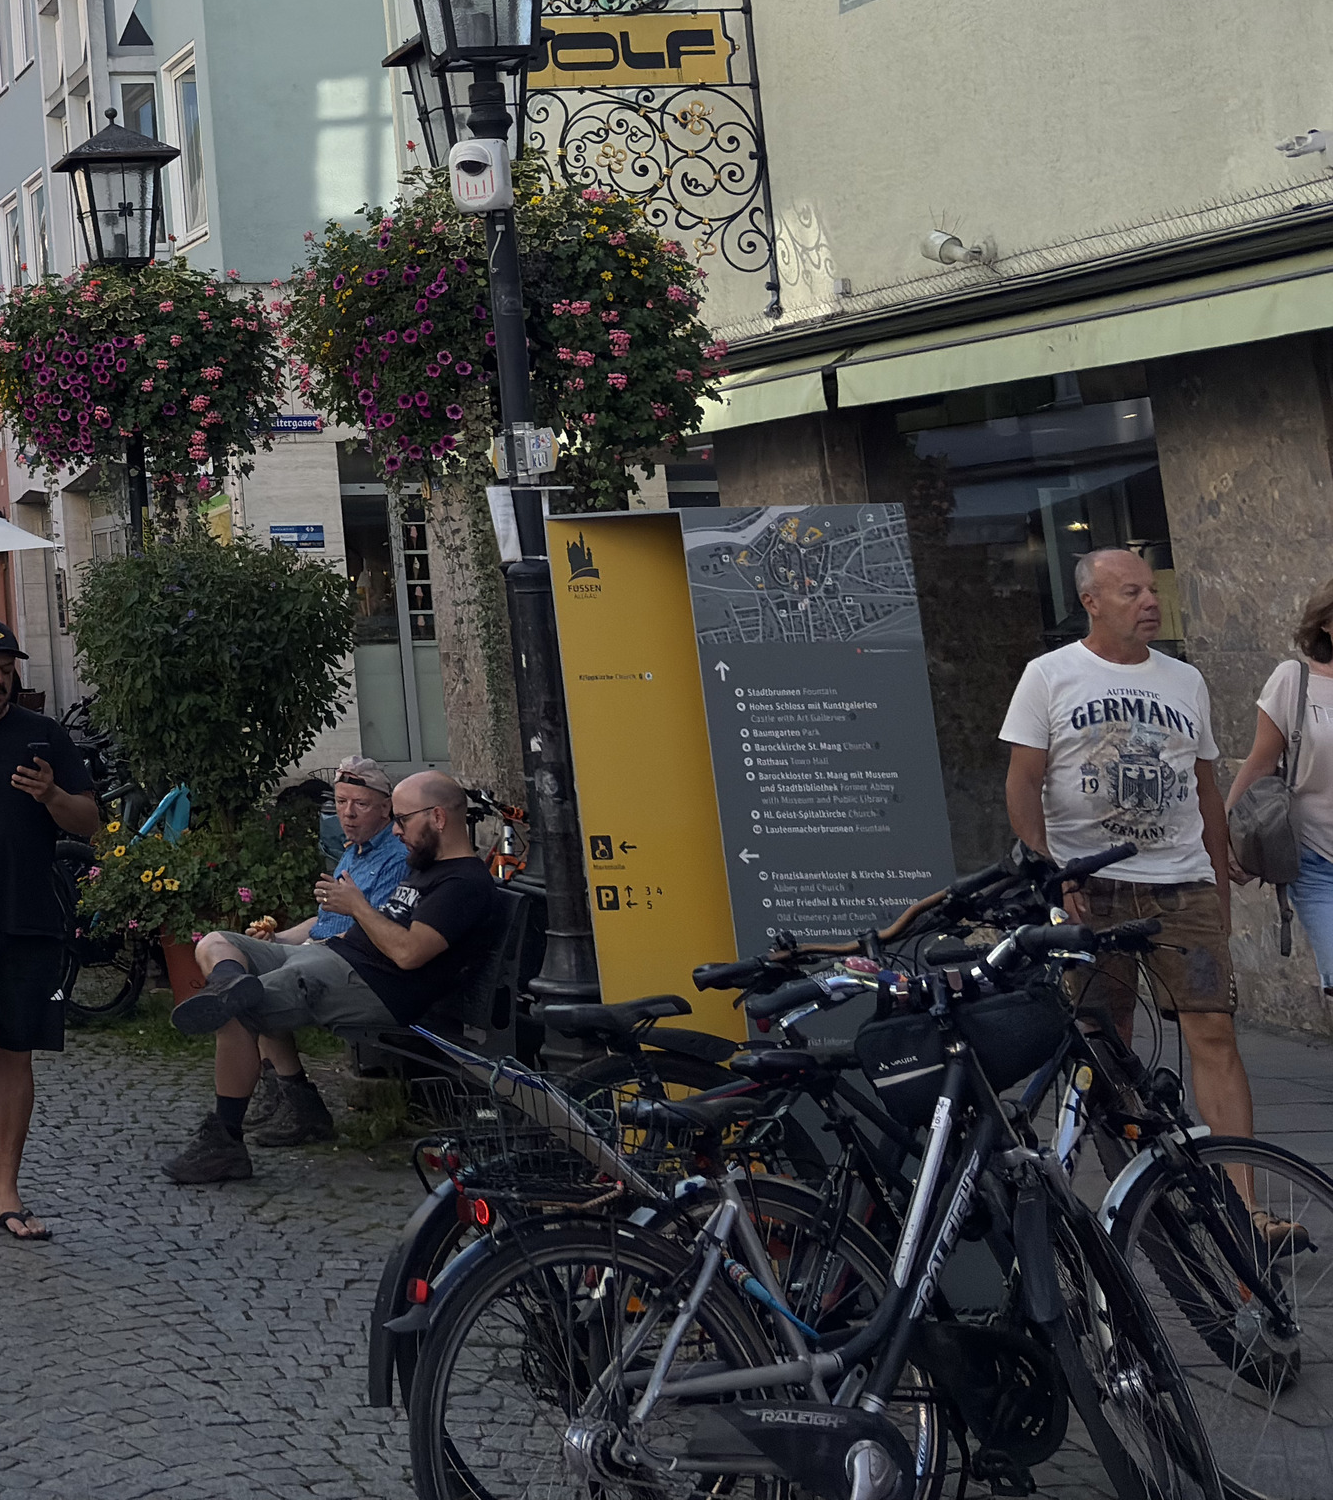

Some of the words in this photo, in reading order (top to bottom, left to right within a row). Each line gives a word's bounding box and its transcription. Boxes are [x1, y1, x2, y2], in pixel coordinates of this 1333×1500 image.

[528, 29, 716, 72] OLF
[747, 688, 801, 697] Stadtbrunnen
[802, 687, 838, 696] Fountain
[1106, 688, 1161, 700] AUTHENTIC
[749, 702, 774, 711] Hohes
[775, 701, 805, 711] Schloss
[807, 701, 821, 710] mit
[822, 701, 878, 711] Kunstgalerien
[751, 714, 775, 723] Castle
[777, 714, 795, 723] with
[796, 713, 809, 722] Art
[810, 713, 846, 722] Galleries
[1071, 697, 1196, 740] GERMANY
[752, 728, 801, 739] Baumgarten
[802, 728, 820, 737] Park
[754, 743, 806, 752] Barockkirche
[819, 742, 842, 753] Mang
[843, 741, 871, 750] Church
[756, 758, 789, 766] Rathaus
[790, 757, 811, 766] Town
[812, 757, 829, 765] Hall
[758, 772, 812, 781] Barockkloster
[826, 771, 849, 781] Mang
[849, 771, 864, 779] mit
[865, 770, 899, 779] Museum
[760, 785, 776, 793] und
[776, 783, 838, 792] Stadtbibliothek
[839, 783, 868, 791] Former
[869, 783, 895, 793] Abbey
[1081, 777, 1100, 794] 19
[761, 796, 780, 805] with
[781, 796, 815, 804] Museum
[816, 795, 831, 804] and
[832, 795, 858, 804] Public
[859, 795, 889, 805] Library
[775, 810, 847, 820] Geist-Spitalkirche
[848, 810, 876, 818] Church
[765, 825, 854, 834] Lautenmacherbrunnen
[855, 825, 891, 833] Fountain
[1101, 818, 1166, 840] GERMANY
[771, 871, 849, 881] Franziskanerkloster
[851, 871, 857, 880] &
[859, 870, 885, 880] Kirche
[898, 869, 932, 880] Stephan
[645, 886, 652, 896] 3
[656, 886, 663, 896] 4
[773, 884, 799, 893] Abbey
[800, 883, 815, 892] and
[816, 883, 845, 892] Church
[646, 900, 653, 910] 5
[775, 898, 795, 907] Alter
[796, 898, 830, 907] Friedhof
[831, 898, 838, 907] &
[839, 897, 866, 907] Kirche
[879, 897, 918, 906] Sebastian
[793, 913, 831, 923] Cemetery
[832, 912, 848, 921] and
[848, 912, 877, 921] Church
[779, 927, 852, 937] on-Sturm-Haus
[760, 1409, 839, 1428] RALEIGH
